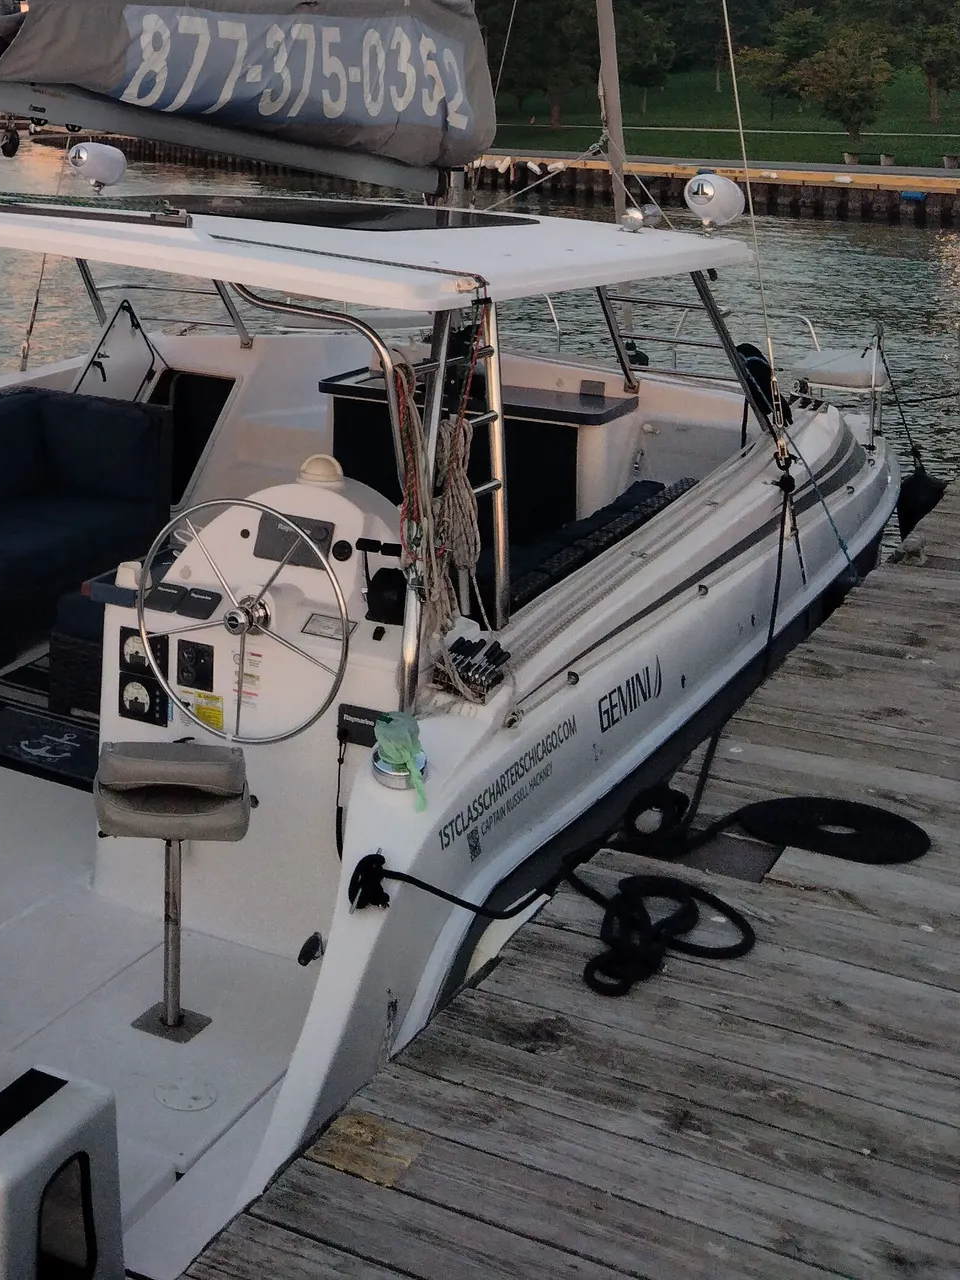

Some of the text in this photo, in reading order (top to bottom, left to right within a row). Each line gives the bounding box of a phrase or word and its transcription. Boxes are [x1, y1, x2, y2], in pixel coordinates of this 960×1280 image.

[119, 13, 468, 130] 877-375-0352
[598, 665, 651, 733] GEMINI
[438, 714, 578, 851] 1STCLASSCHARTERSCHICAGO.COM
